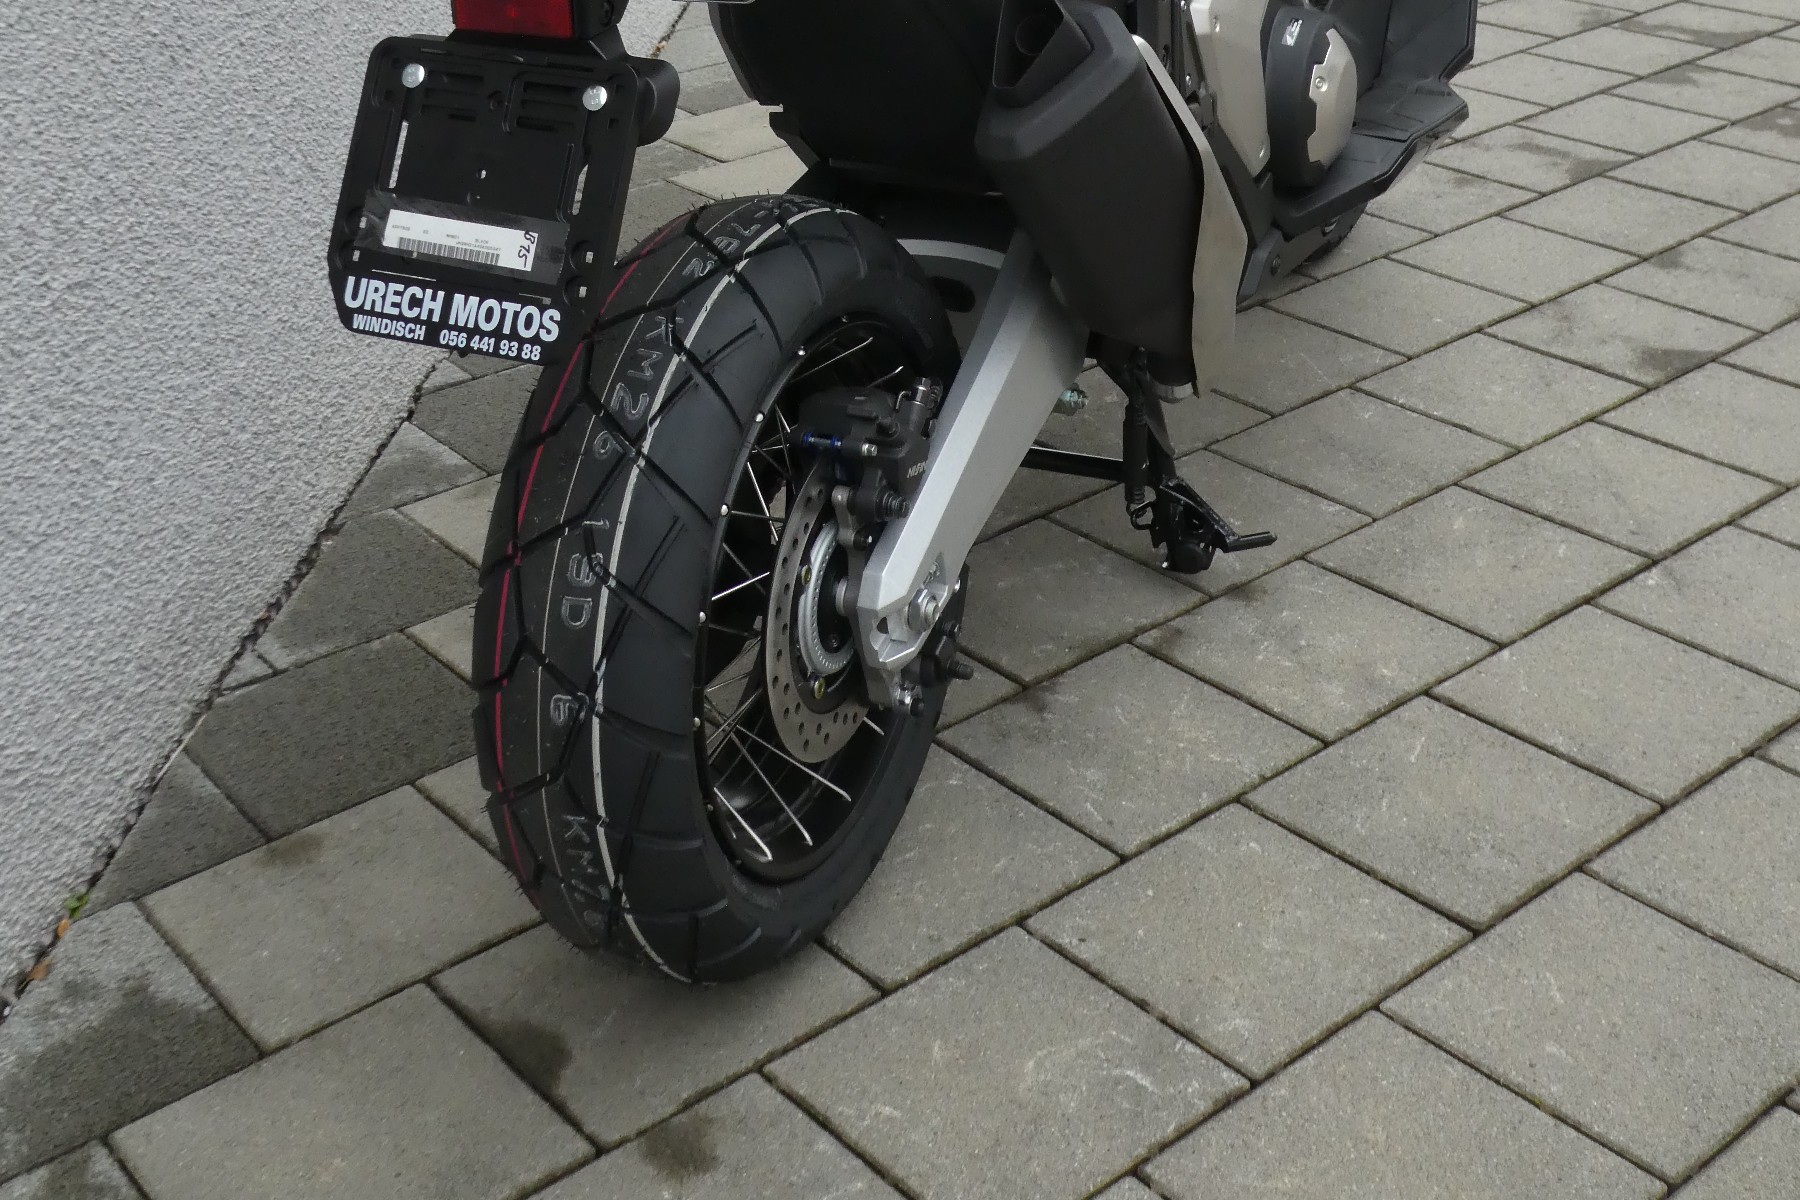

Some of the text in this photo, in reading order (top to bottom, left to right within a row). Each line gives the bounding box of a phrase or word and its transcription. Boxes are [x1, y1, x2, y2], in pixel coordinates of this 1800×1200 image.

[344, 275, 561, 342] URECH MOTOS
[352, 313, 542, 361] WINDISCH 056 441 93 88
